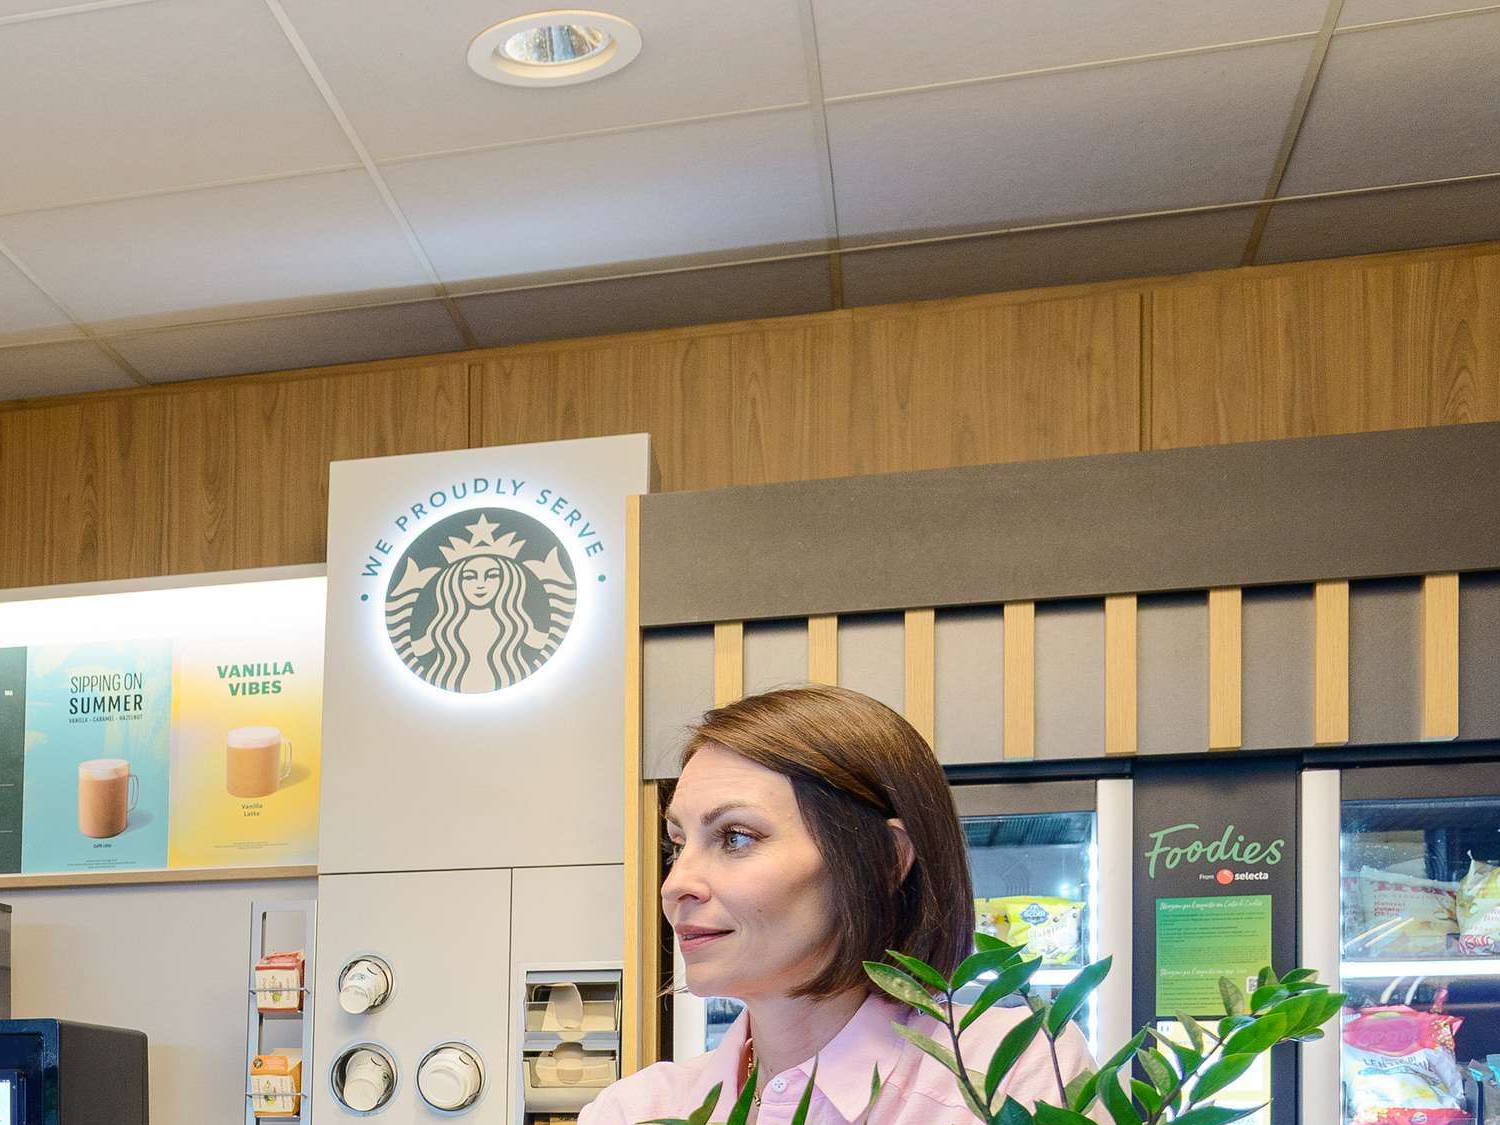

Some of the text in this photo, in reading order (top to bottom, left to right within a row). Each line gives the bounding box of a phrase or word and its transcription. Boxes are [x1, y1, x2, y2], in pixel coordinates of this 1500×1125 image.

[362, 478, 604, 578] WE PROUDLY SERVE
[216, 661, 295, 679] VANILLA
[70, 671, 143, 694] SIPPING ON
[228, 680, 282, 697] VIBES
[69, 694, 143, 715] SUMMER
[1144, 823, 1285, 879] Foodies
[1199, 871, 1269, 881] From selecta
